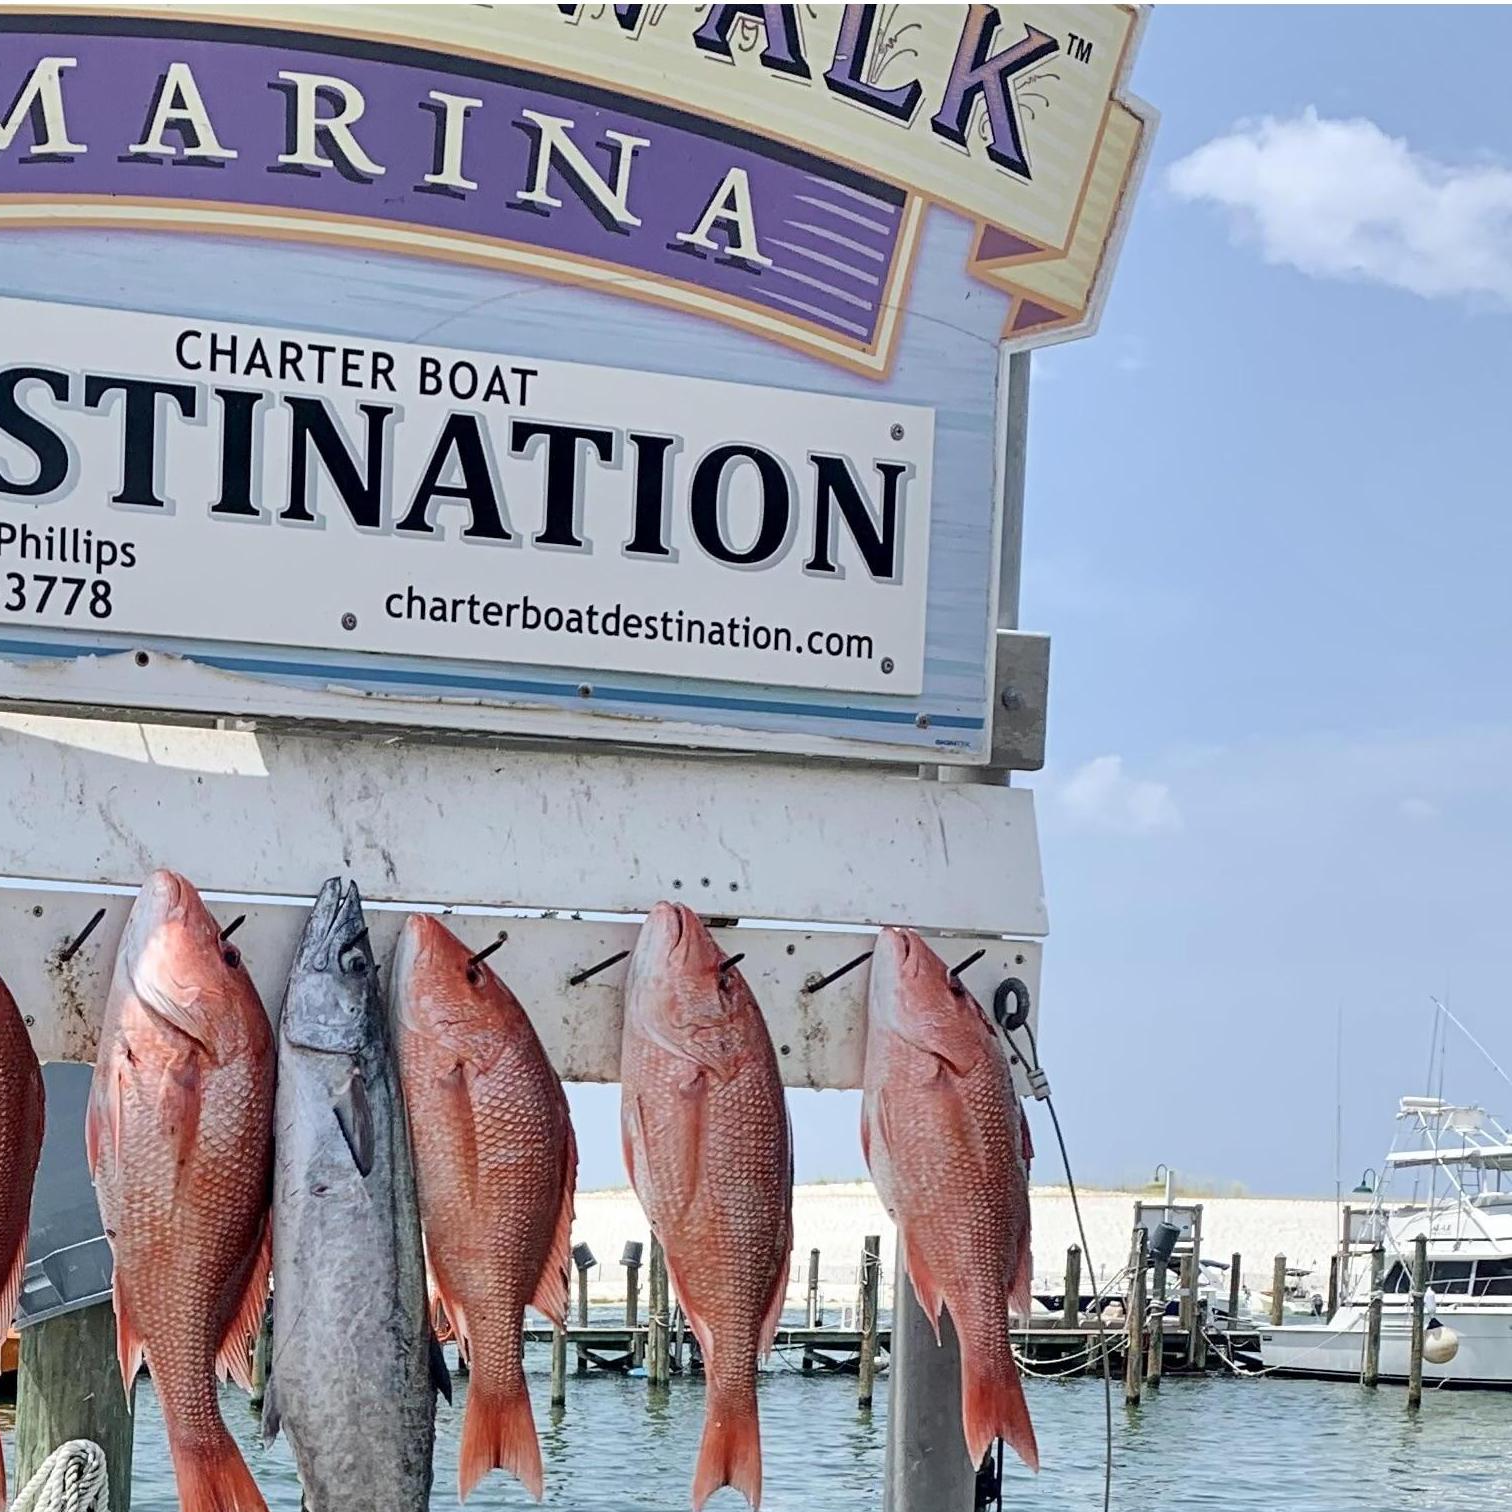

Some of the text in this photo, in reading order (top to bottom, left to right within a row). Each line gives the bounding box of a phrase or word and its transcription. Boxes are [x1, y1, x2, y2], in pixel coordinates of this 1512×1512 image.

[554, 4, 1059, 180] ALK
[175, 330, 539, 407] CHARTER BOAT
[385, 586, 875, 661] charterboatdestination.com
